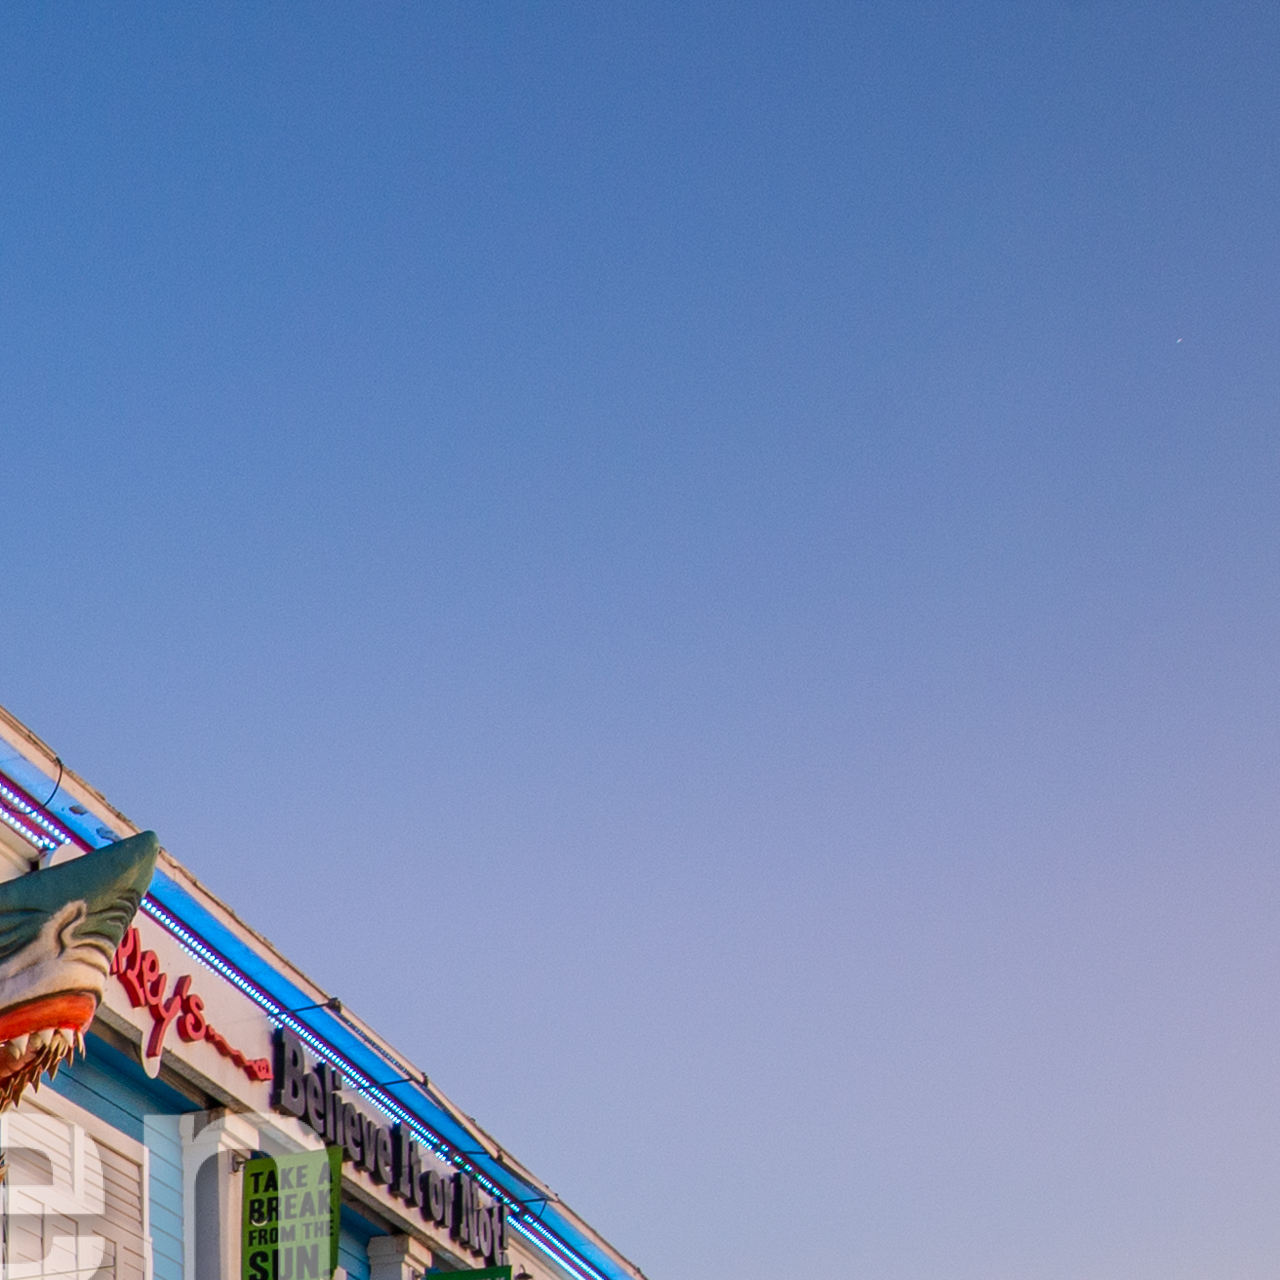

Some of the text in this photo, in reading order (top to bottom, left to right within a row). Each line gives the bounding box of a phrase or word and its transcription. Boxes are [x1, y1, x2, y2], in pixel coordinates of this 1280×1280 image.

[272, 1027, 393, 1186] Believe
[251, 1162, 333, 1194] TAKE A
[249, 1189, 334, 1226] BREAK
[248, 1220, 334, 1247] FROM THE
